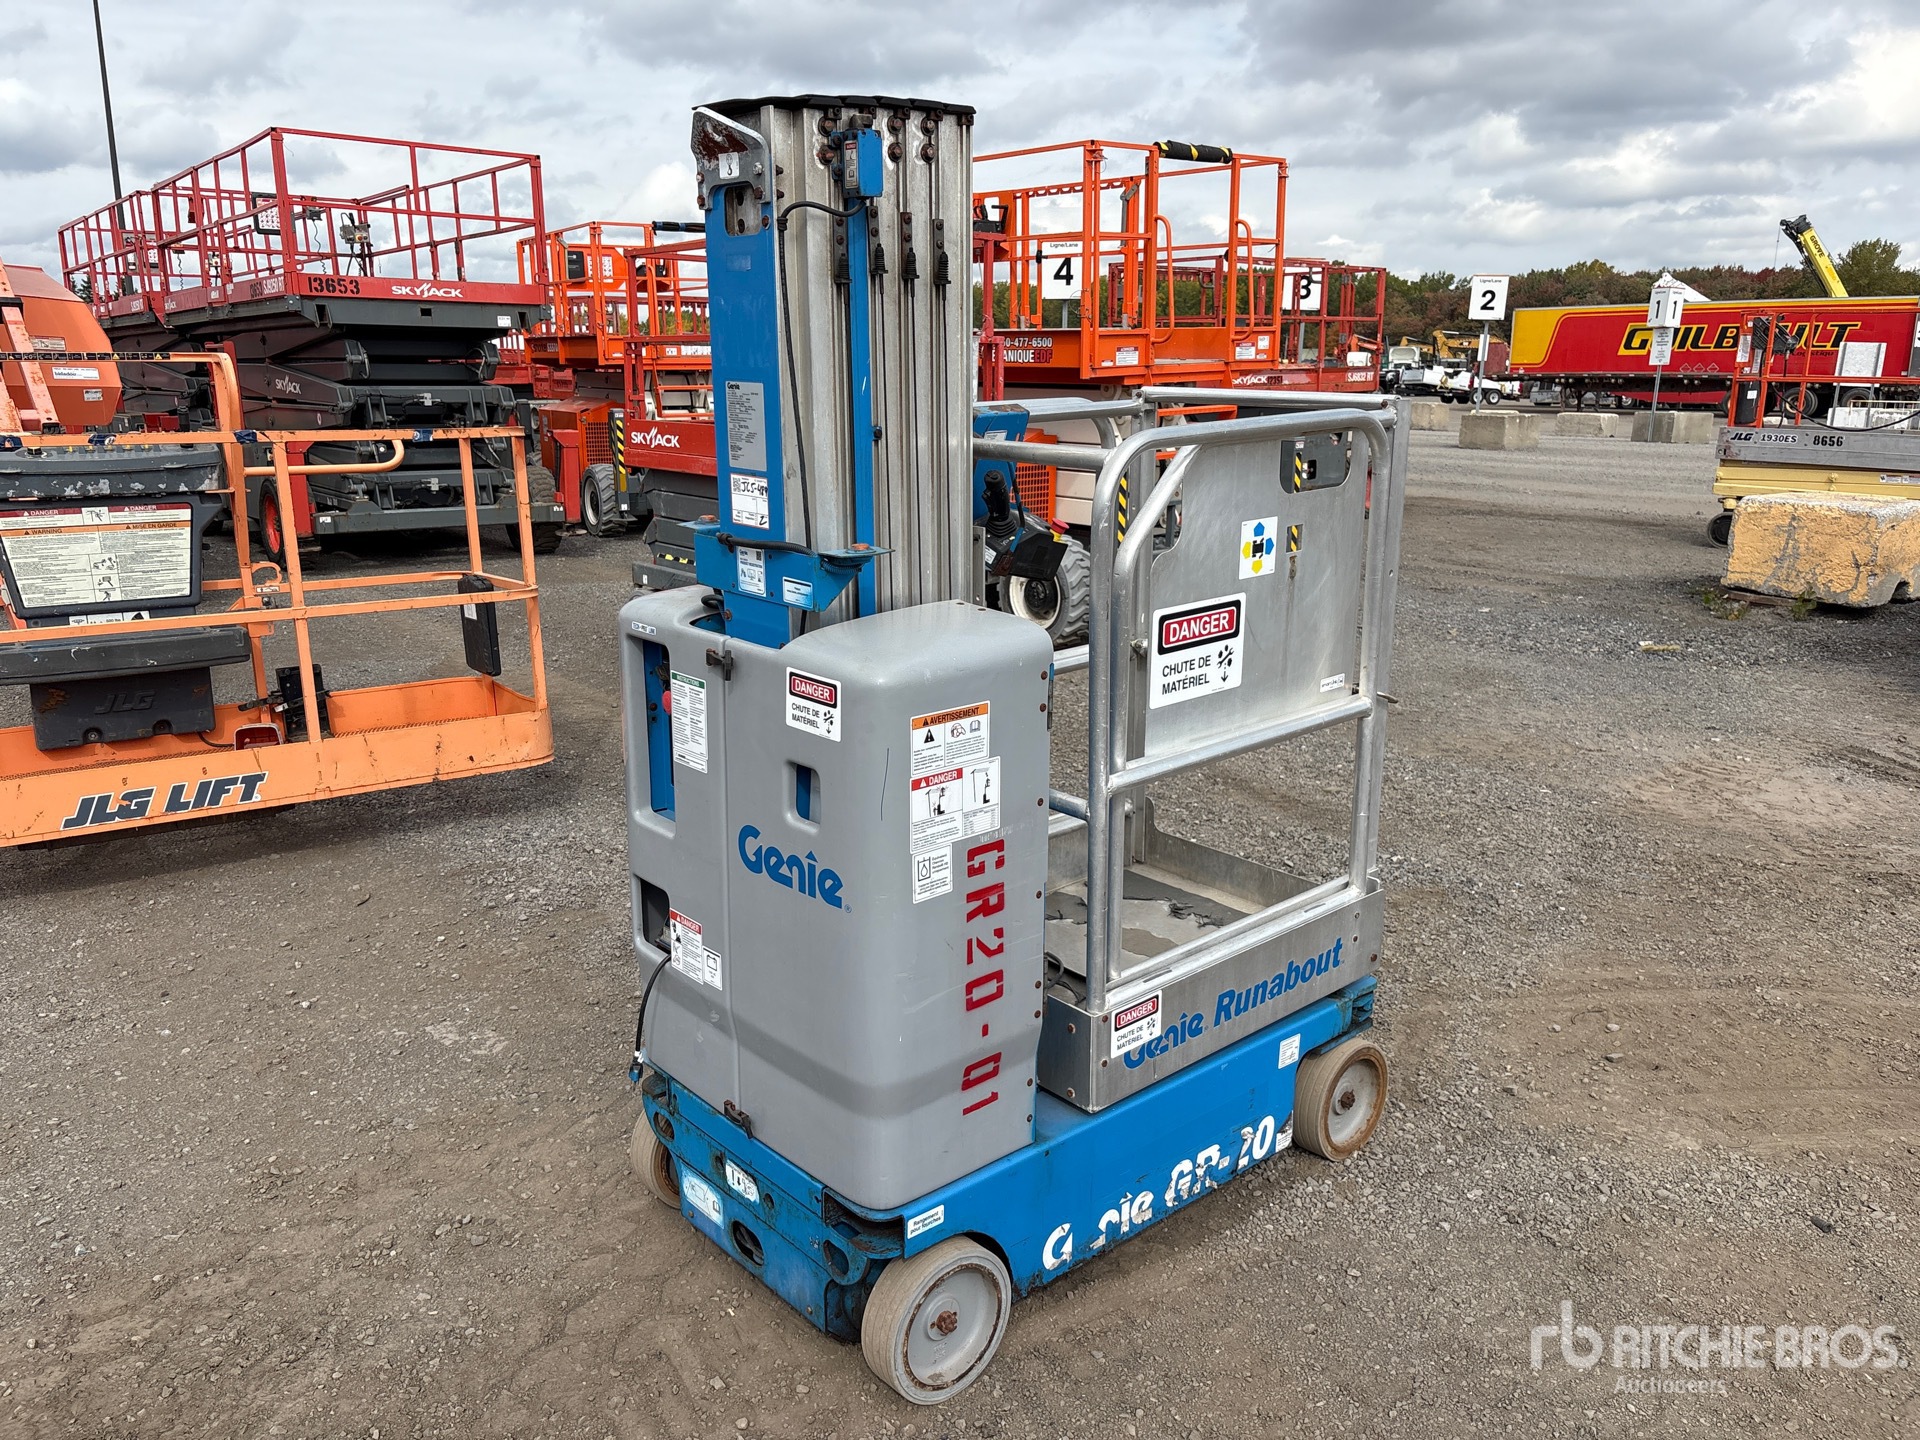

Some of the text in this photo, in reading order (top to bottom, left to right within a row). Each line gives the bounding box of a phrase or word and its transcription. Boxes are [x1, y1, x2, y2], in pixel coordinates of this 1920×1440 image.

[1810, 235, 1824, 259] GROVE
[1053, 257, 1074, 286] 4
[307, 276, 361, 295] 13653
[391, 282, 464, 299] SKYJACK
[1299, 275, 1312, 300] 3
[1480, 290, 1496, 311] 2
[1655, 300, 1661, 319] 1
[1672, 300, 1678, 319] 1
[275, 374, 302, 395] SKYJACK
[631, 426, 681, 448] SKYJACK
[1730, 432, 1845, 447] JLG 1930ES 8656
[130, 504, 157, 512] DANGER
[31, 528, 63, 536] WARNING
[1169, 612, 1229, 642] DANGER
[1162, 655, 1211, 677] CHUTE DE
[795, 679, 830, 701] DANGER
[1162, 673, 1210, 695] MATÉRIEL
[94, 691, 156, 715] JLG
[791, 702, 820, 718] CHUTE DE
[791, 712, 820, 729] MATÉRIEL
[929, 707, 980, 725] AVERTISSEMENT
[928, 770, 958, 785] DANGER
[60, 771, 269, 831] JLG LIFT
[738, 824, 844, 909] Genie
[680, 916, 700, 933] DANGER
[1213, 937, 1344, 1028] Runabout
[1120, 1002, 1153, 1024] DANGER
[1116, 1025, 1144, 1042] CHUTE DE
[913, 1211, 939, 1226] Rangement
[1042, 1191, 1155, 1270] Gnie
